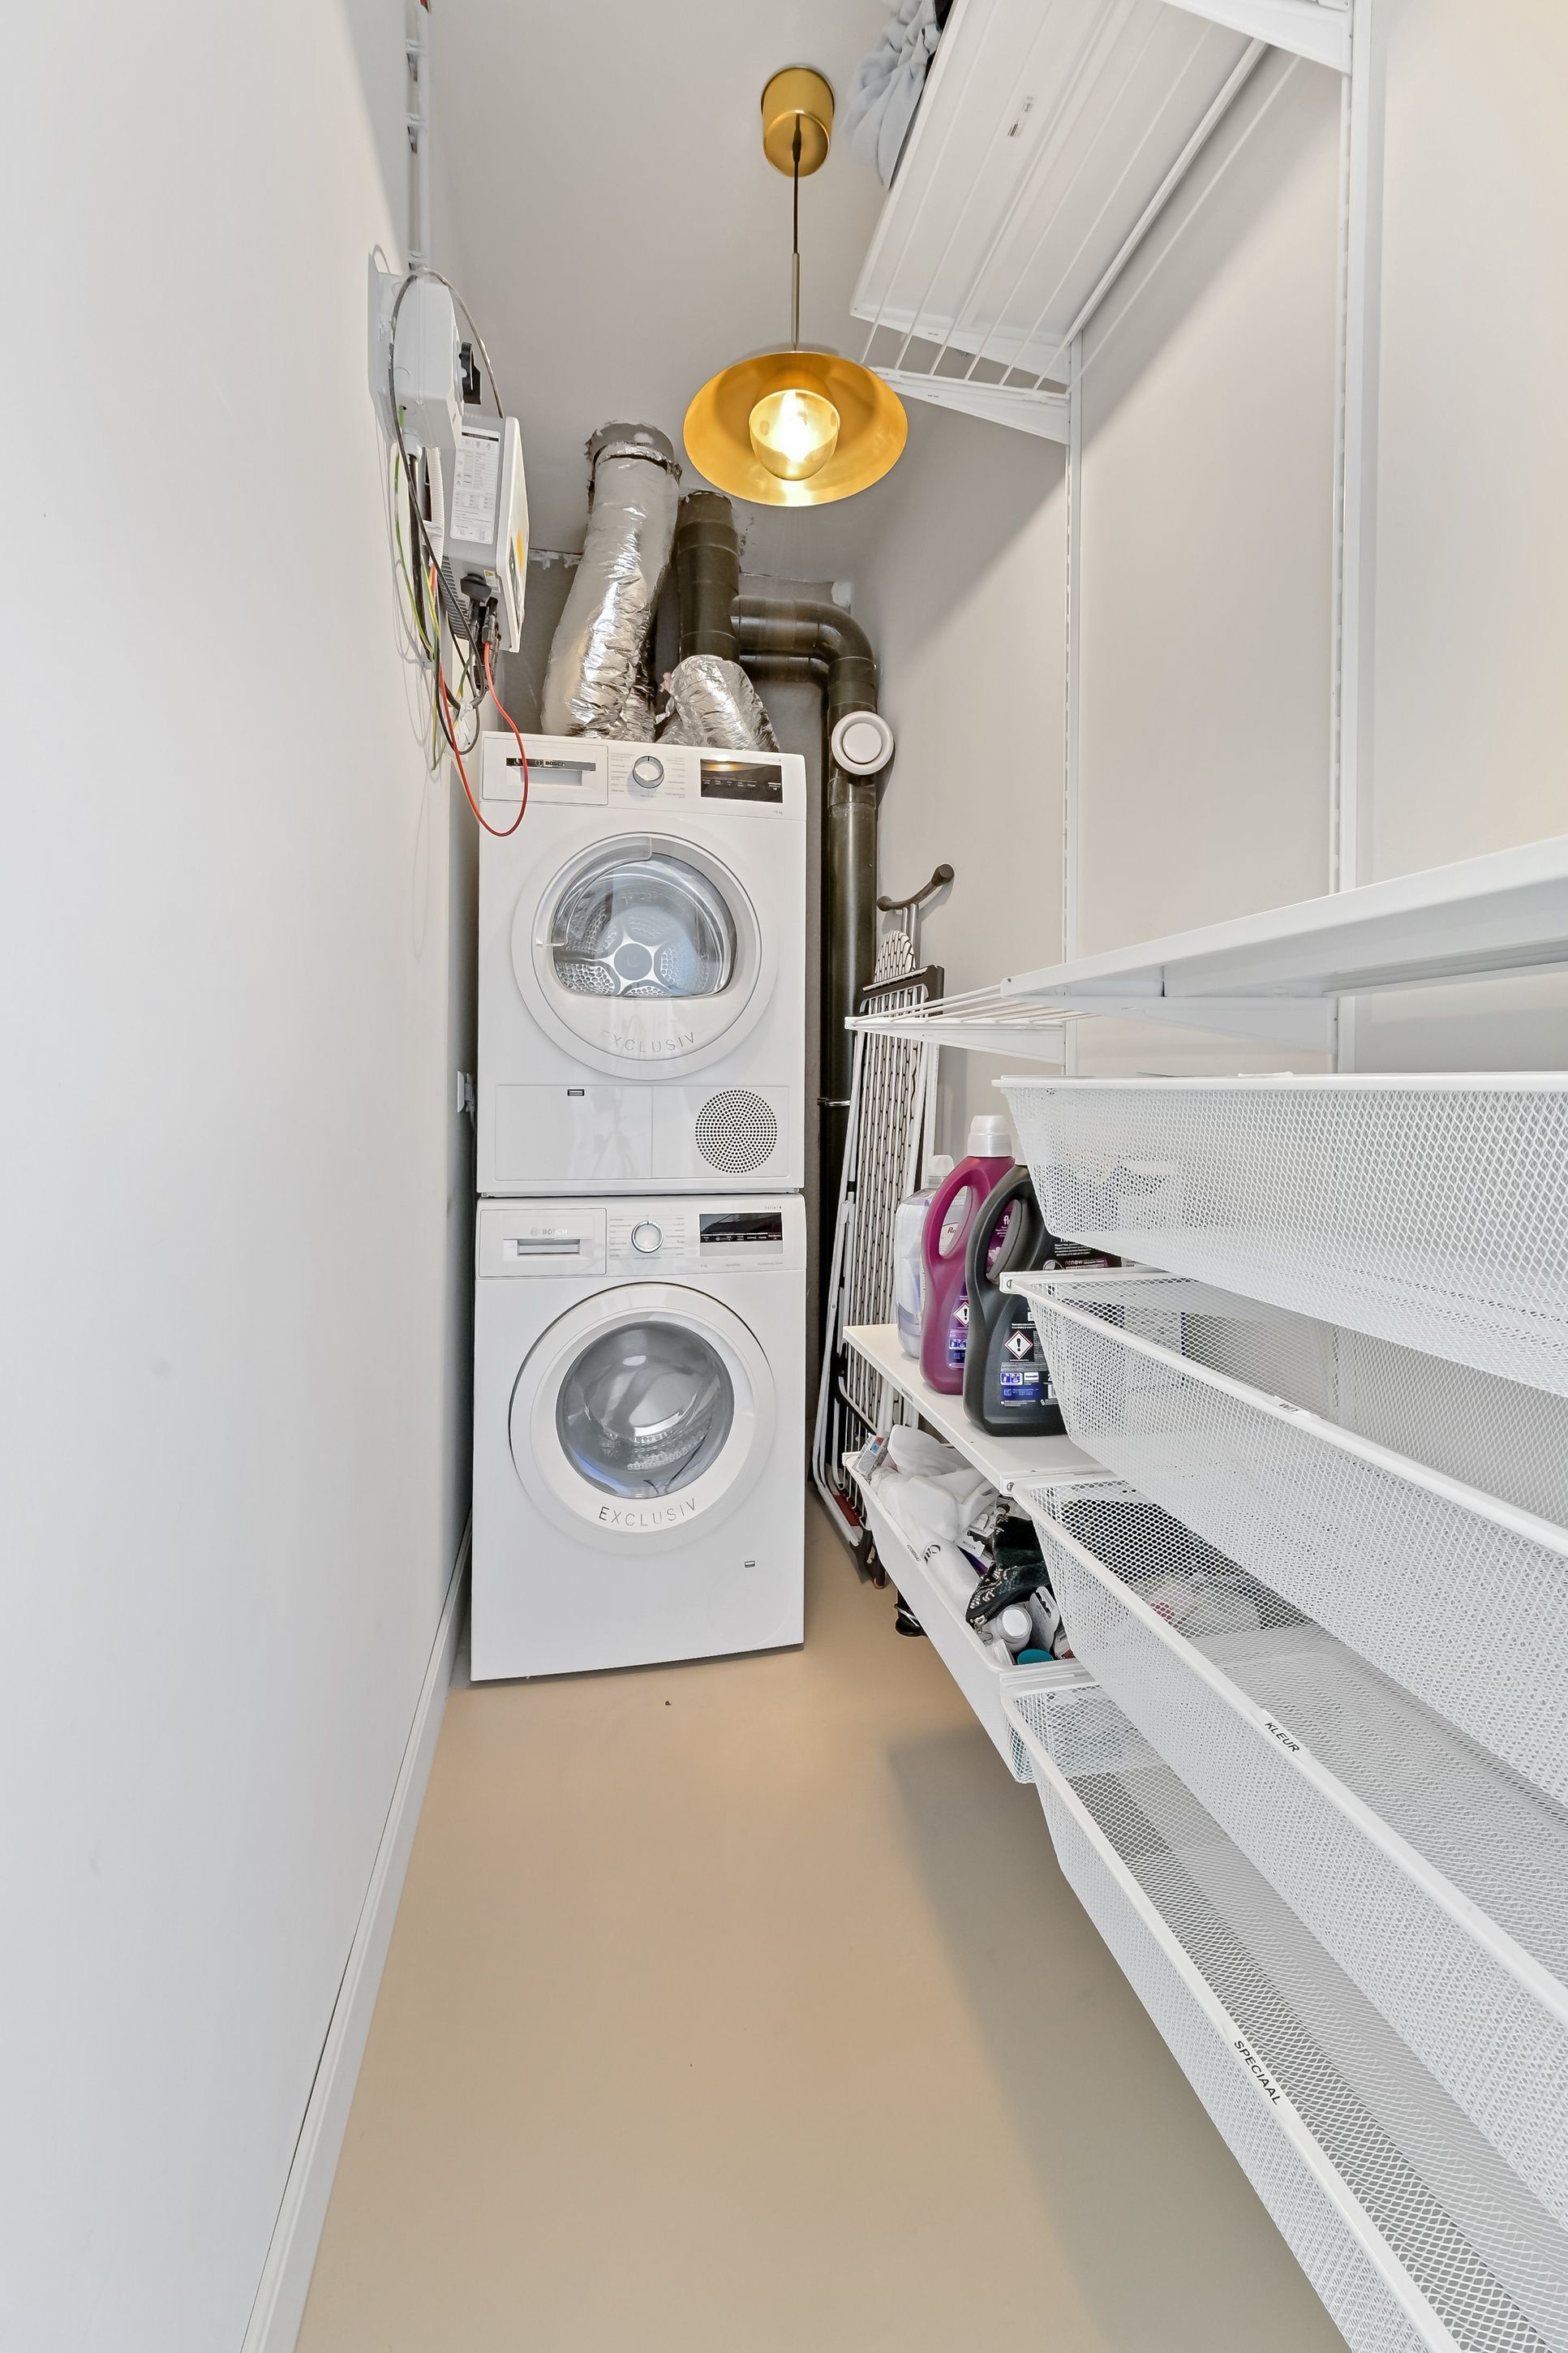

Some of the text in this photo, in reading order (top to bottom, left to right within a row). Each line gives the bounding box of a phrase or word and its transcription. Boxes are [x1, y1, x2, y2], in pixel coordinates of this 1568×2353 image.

[598, 1498, 696, 1527] EXCLUSIV
[1265, 1722, 1300, 1753] KLEUR
[1234, 2041, 1281, 2106] SPECIAAL
